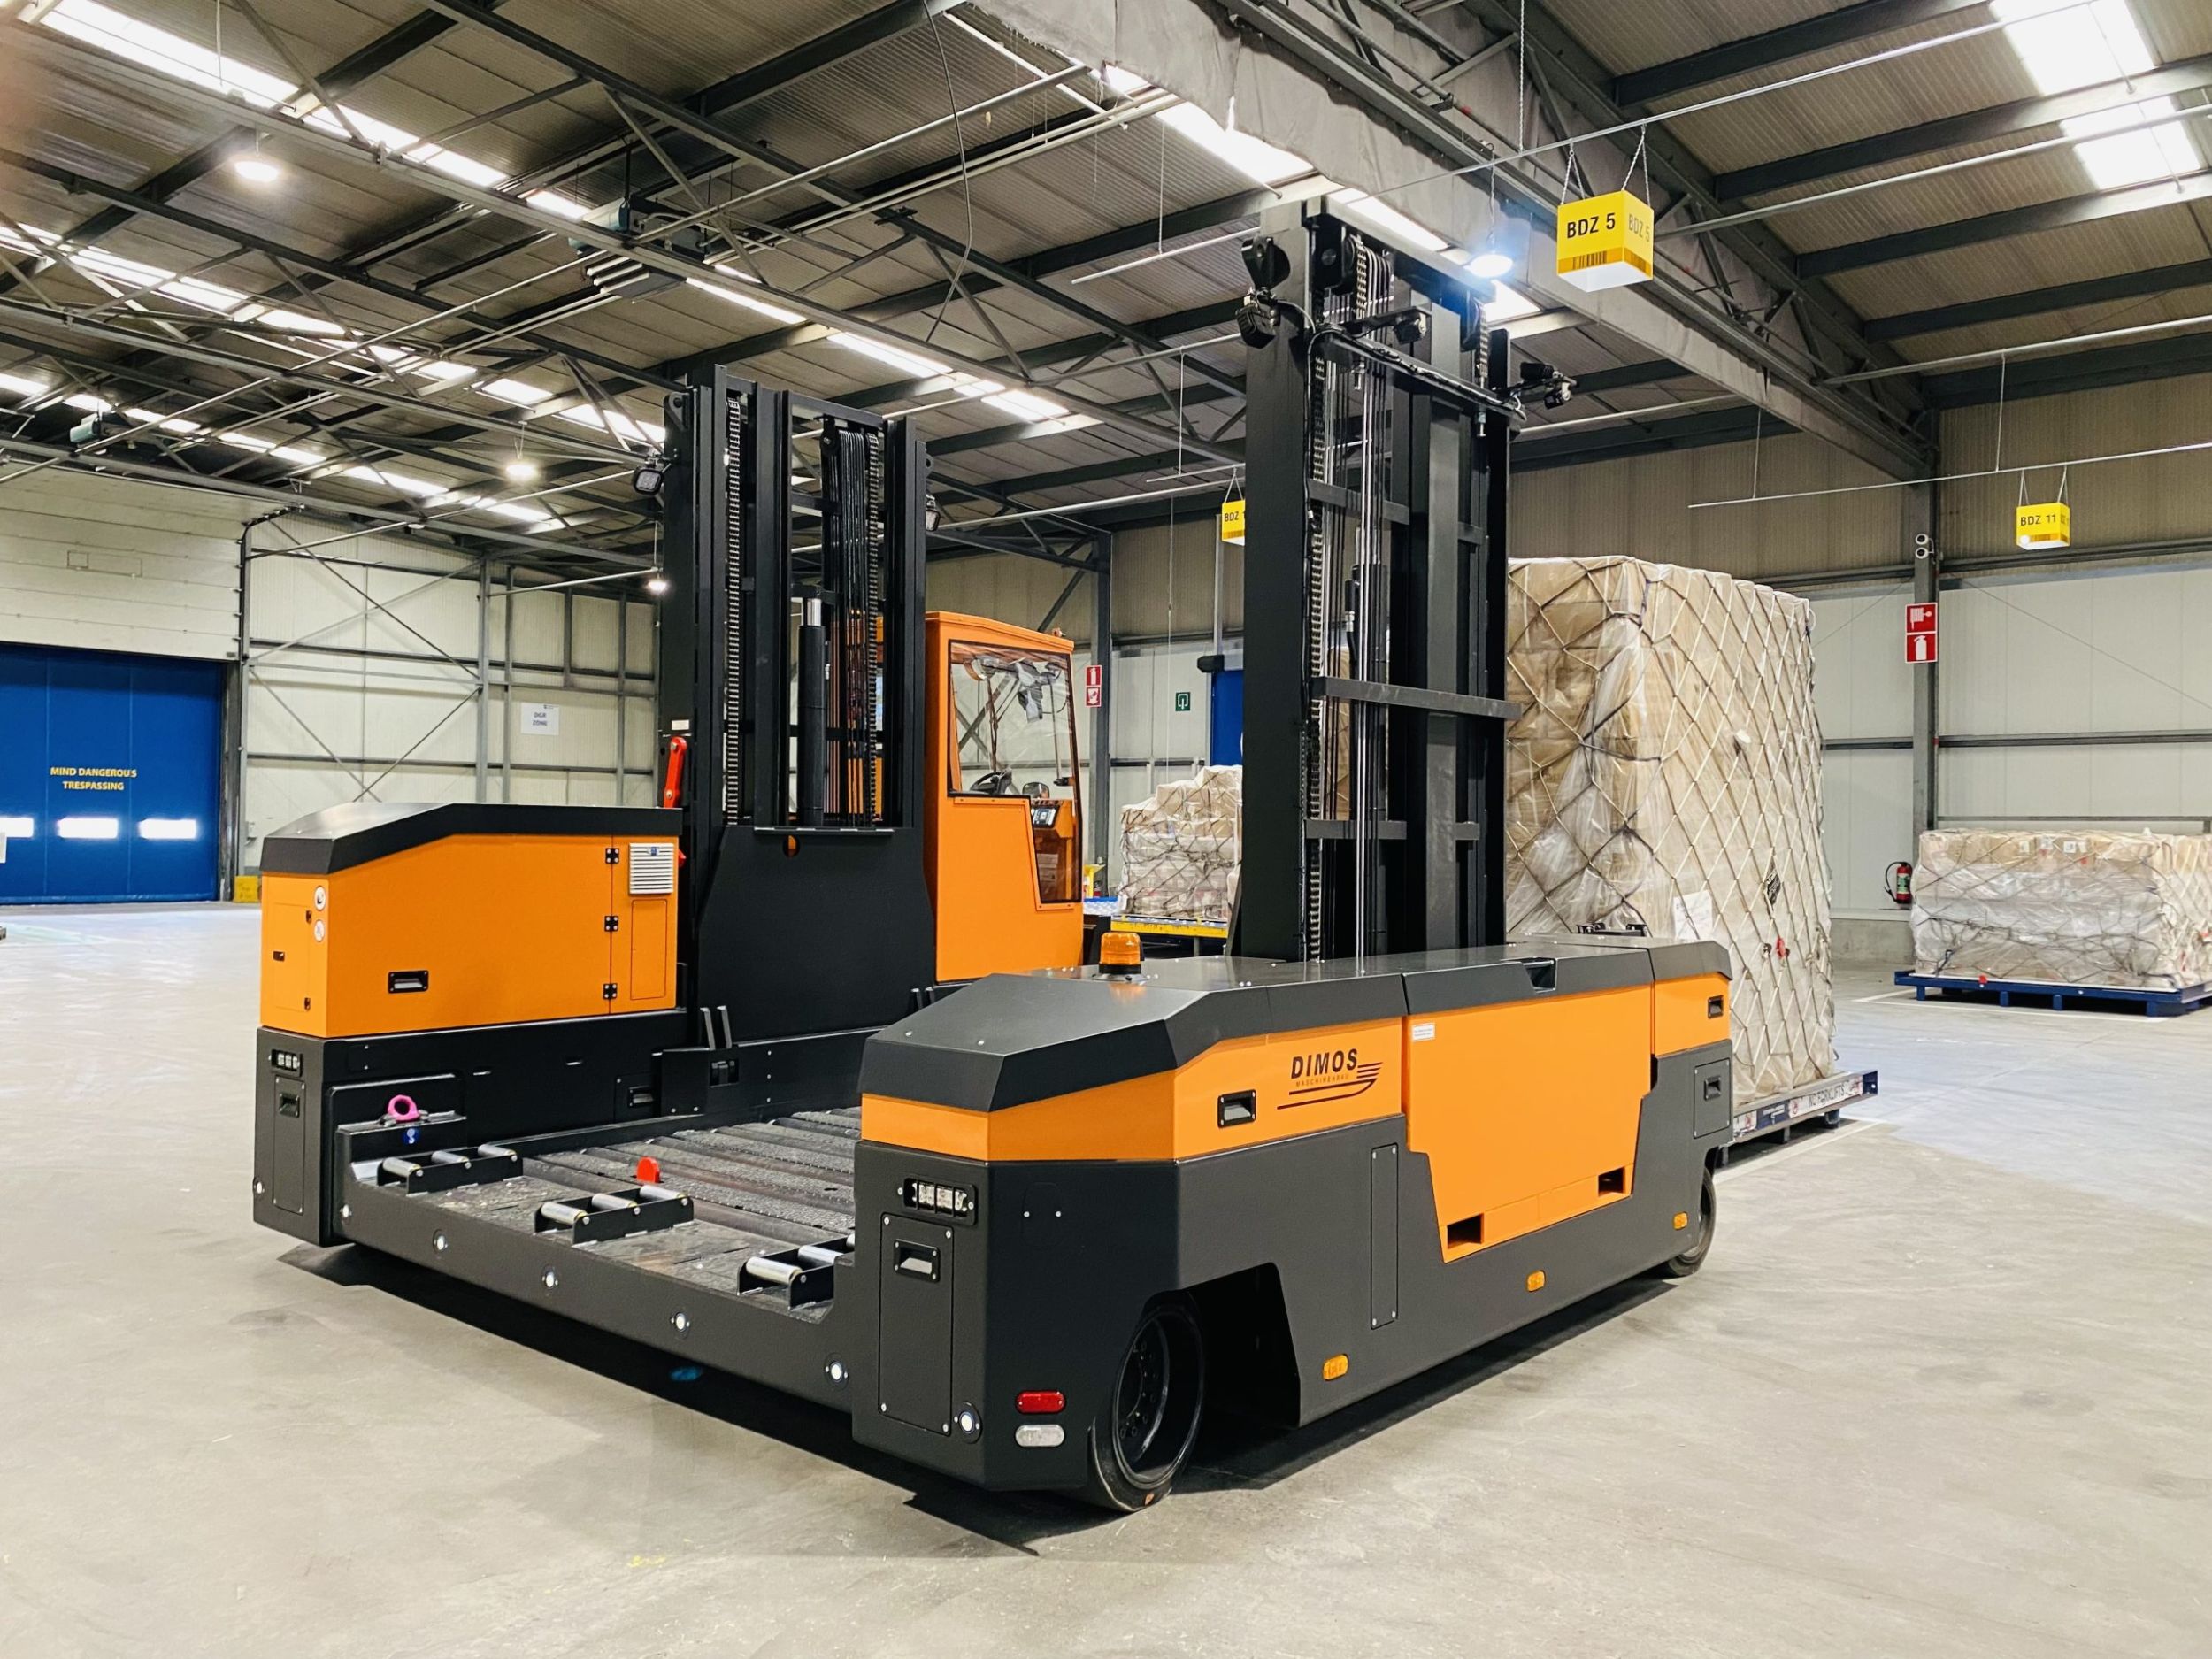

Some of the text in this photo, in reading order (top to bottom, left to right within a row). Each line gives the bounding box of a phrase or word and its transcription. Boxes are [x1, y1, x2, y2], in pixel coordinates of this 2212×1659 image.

[1567, 212, 1616, 239] BDZ 5
[1628, 213, 1650, 242] BDZ 5
[1224, 511, 1240, 522] BDZ
[2020, 515, 2041, 526] BDZ
[2046, 514, 2056, 524] 11
[50, 767, 137, 778] MIND DANGEROUS
[62, 781, 125, 790] TRESPASSING
[1291, 1048, 1358, 1079] DIMOS
